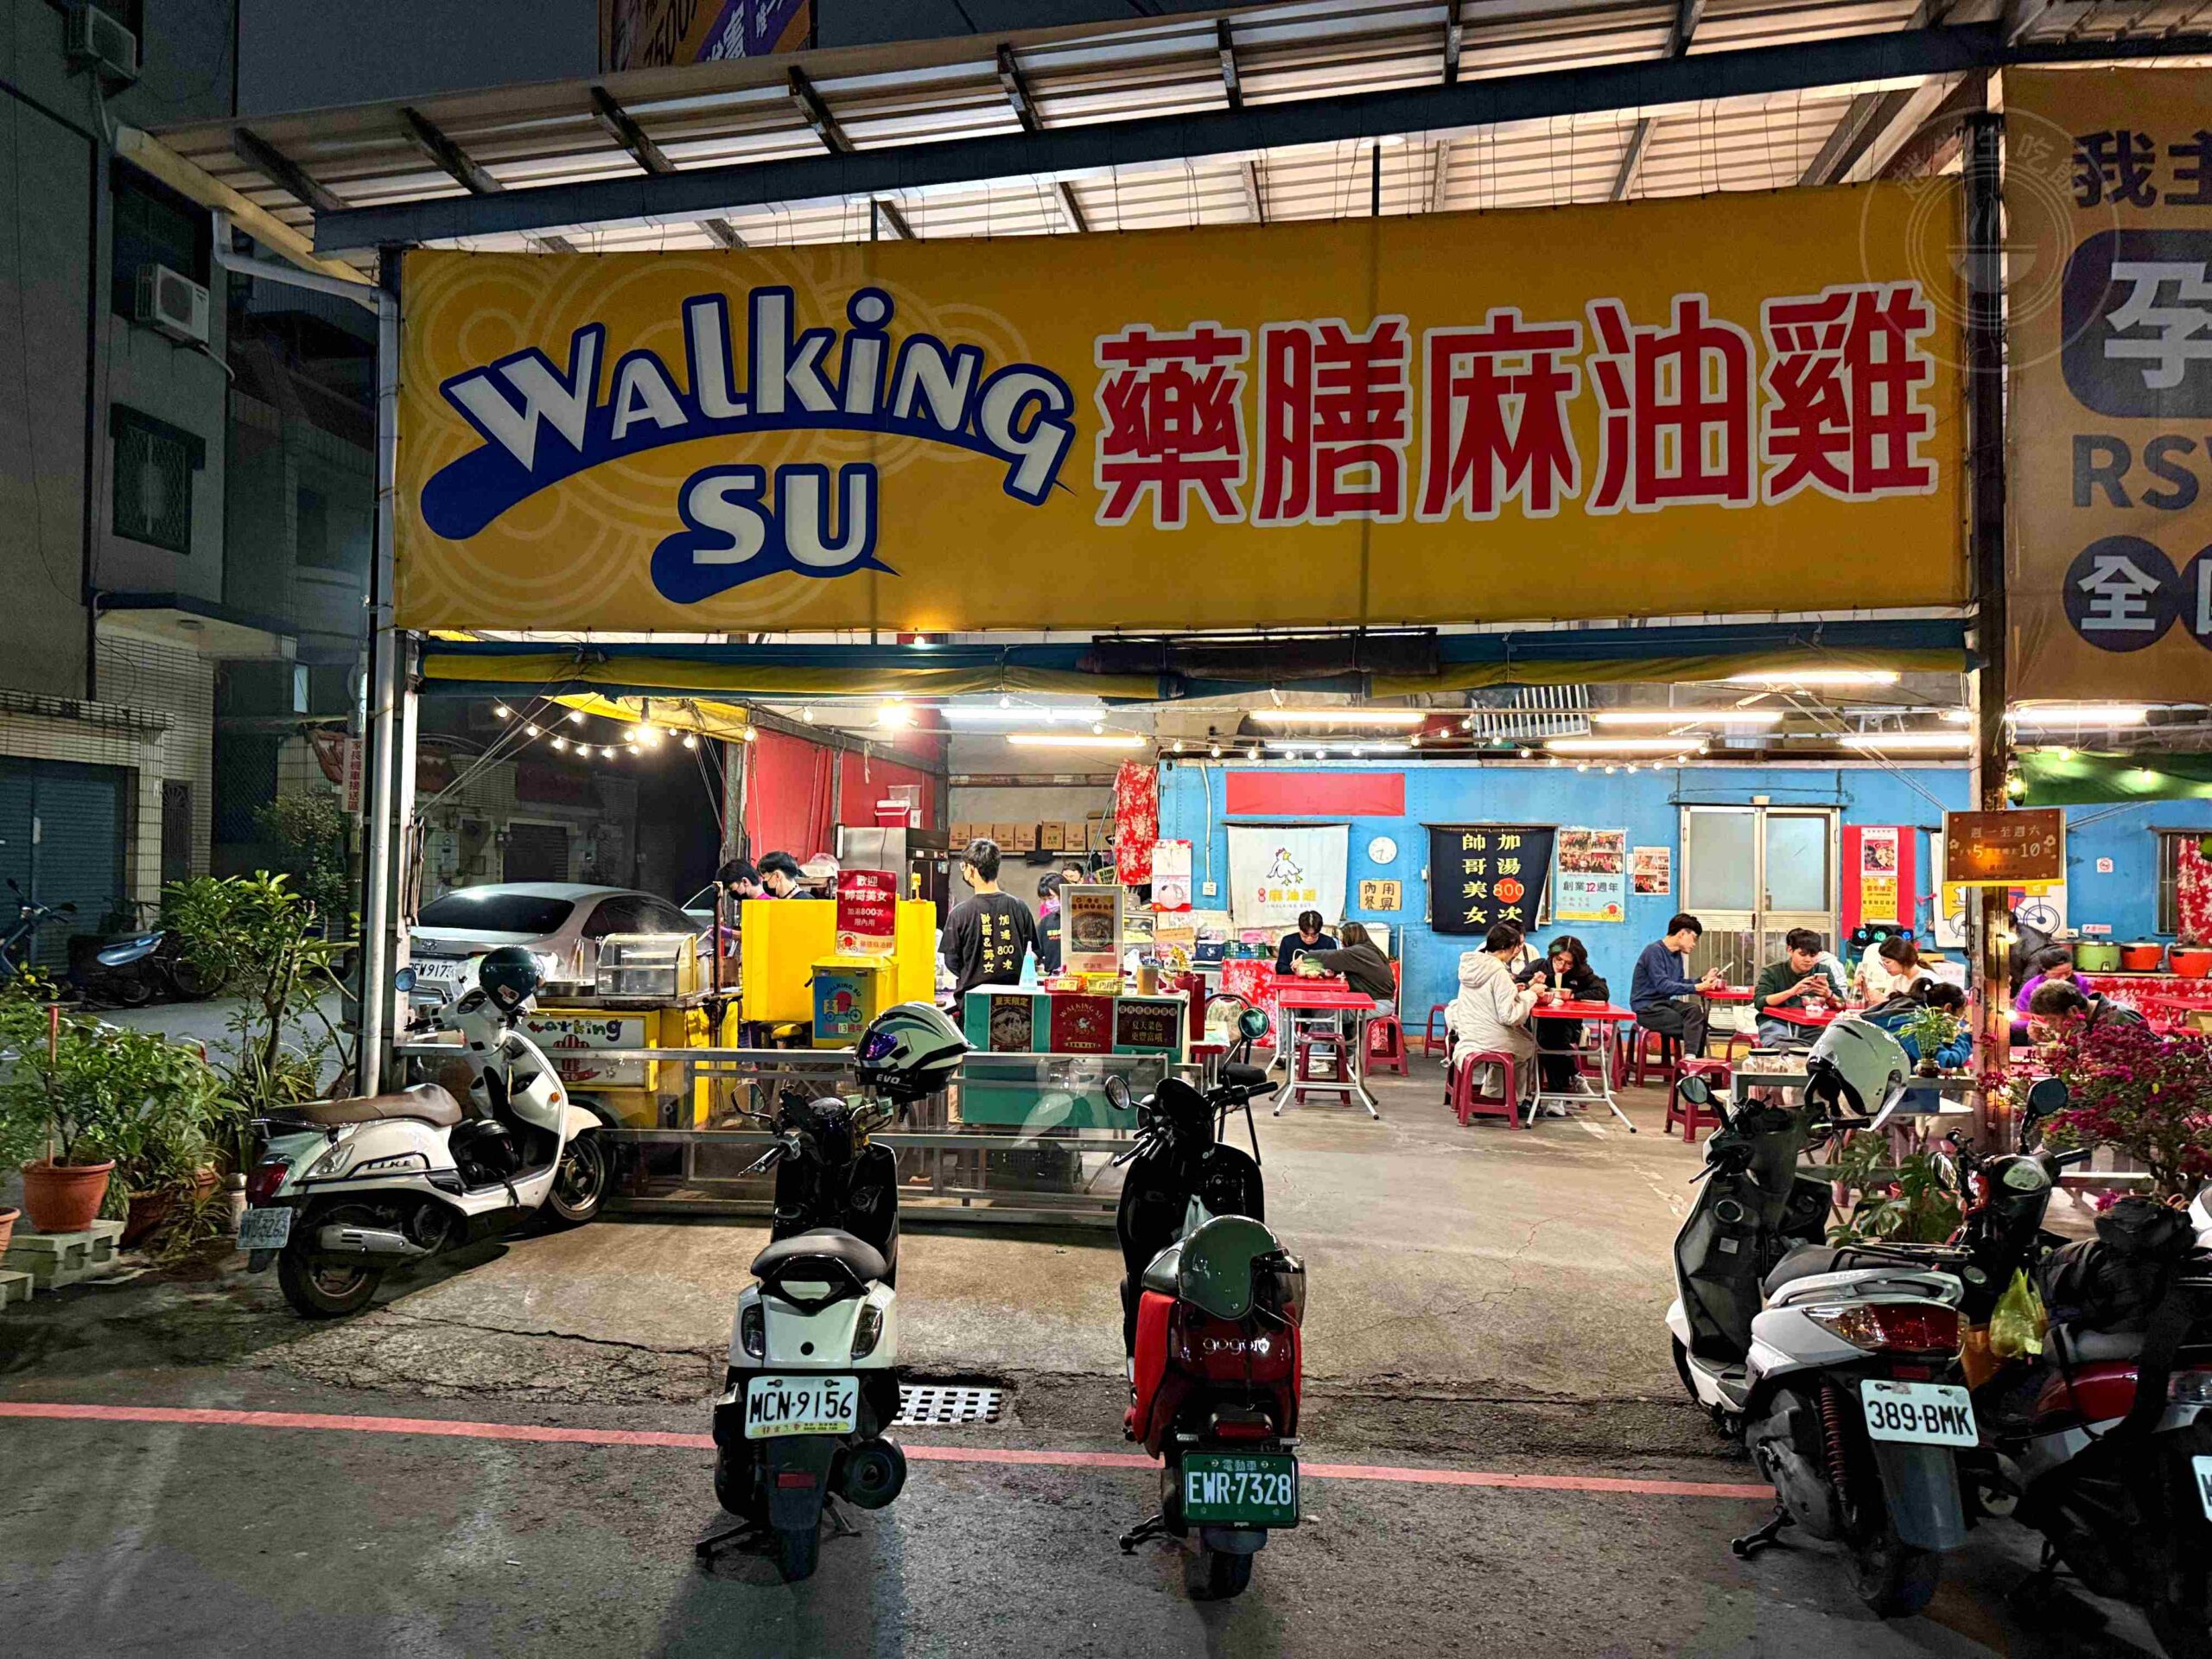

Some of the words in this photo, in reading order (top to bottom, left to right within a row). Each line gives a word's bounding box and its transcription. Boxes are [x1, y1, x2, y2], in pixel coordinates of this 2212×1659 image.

[2104, 262, 2212, 389] 孕
[1095, 281, 1938, 526] 藥膳麻油雞
[2073, 435, 2212, 511] RS
[684, 467, 873, 574] SU
[2077, 556, 2212, 634] 全
[1971, 825, 2040, 838] 週一至週六
[856, 874, 878, 887] 歡迎
[1462, 833, 1488, 924] 帥哥美女
[1493, 834, 1524, 923] 加湯800次
[1563, 881, 1618, 893] 創業12週年
[844, 890, 887, 902] 帥哥美女
[997, 914, 1014, 970] 加湯800次
[1059, 1002, 1094, 1018] WALKING
[876, 1074, 900, 1084] EVO
[749, 1391, 853, 1423] MCN-9156
[1868, 1401, 1973, 1435] 389-BMK
[1223, 1459, 1257, 1471] 電動車
[1188, 1471, 1292, 1505] EWR-7328
